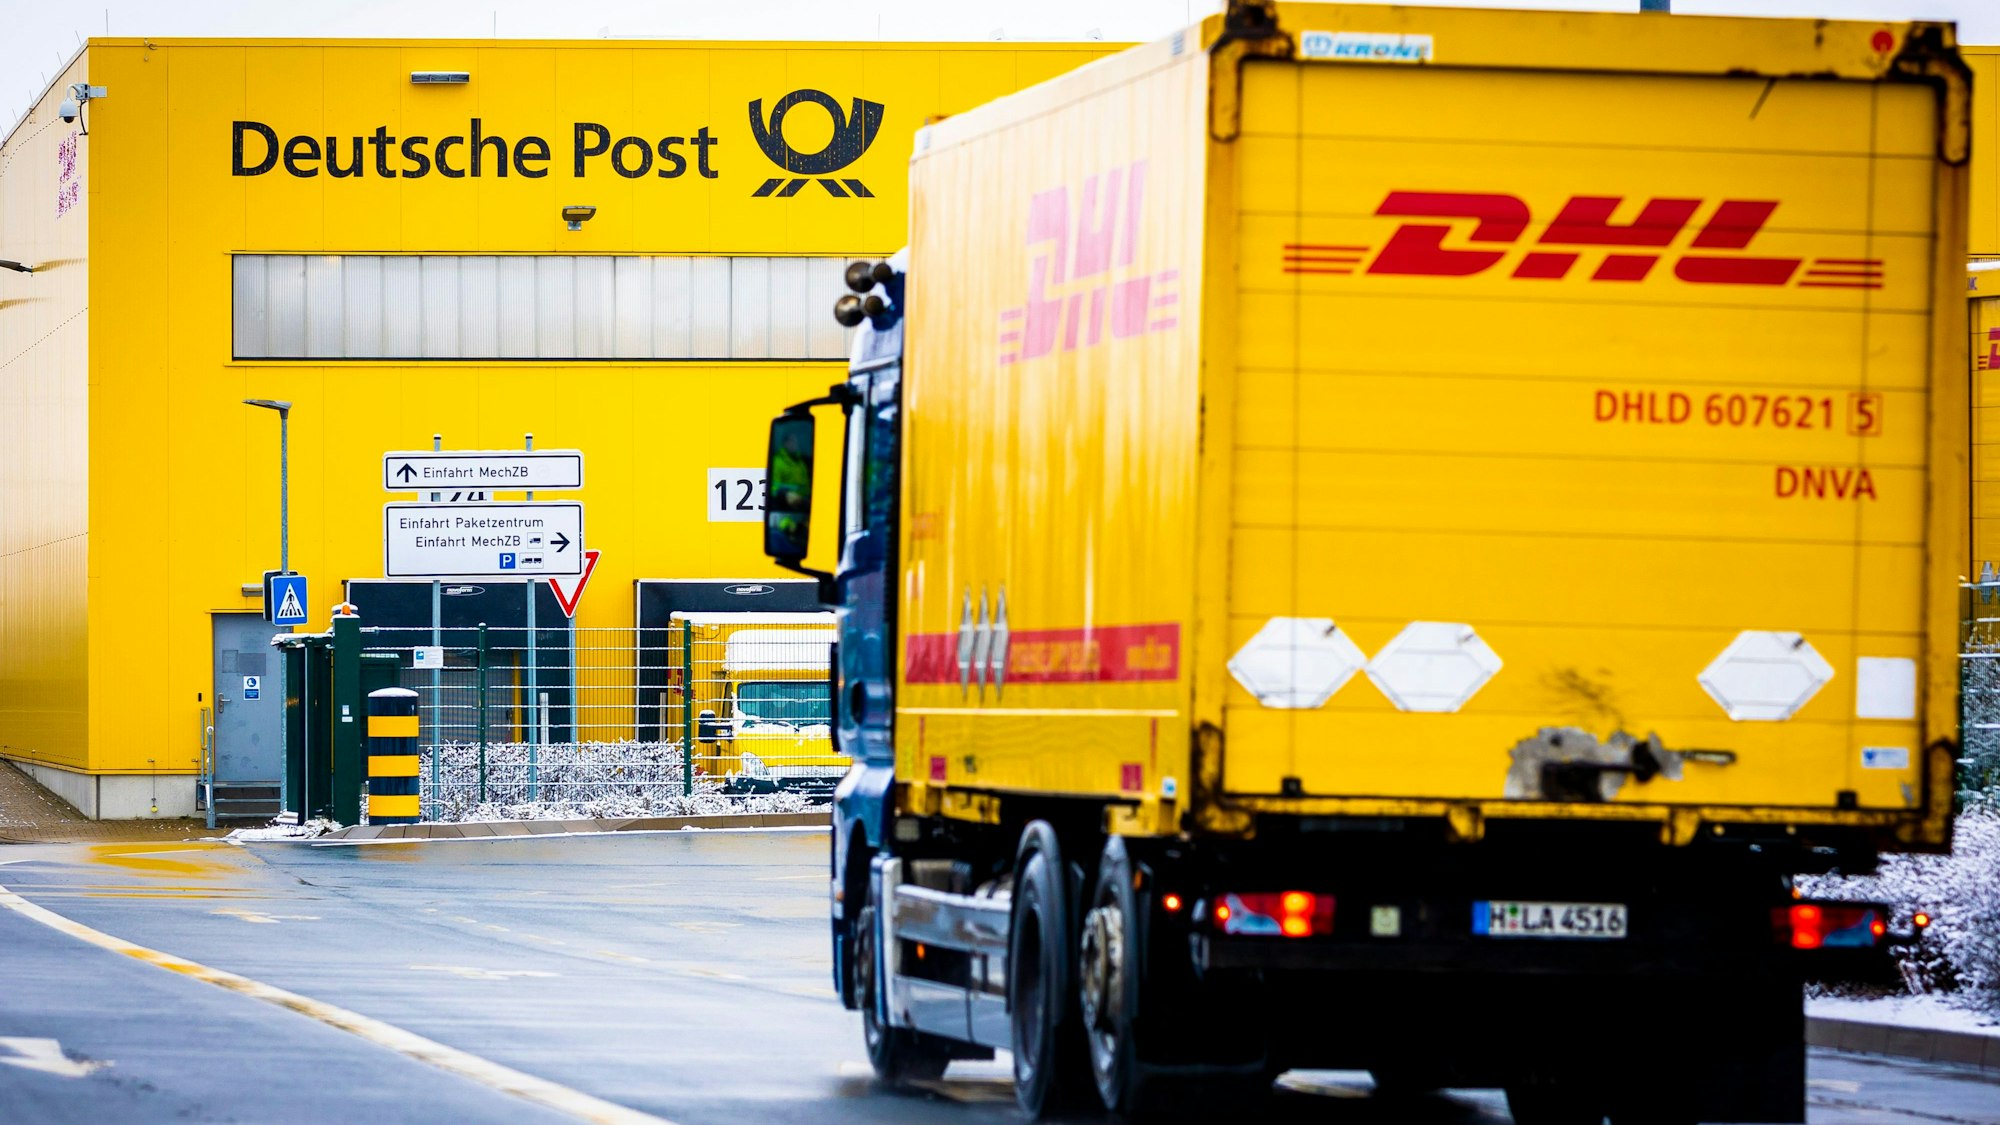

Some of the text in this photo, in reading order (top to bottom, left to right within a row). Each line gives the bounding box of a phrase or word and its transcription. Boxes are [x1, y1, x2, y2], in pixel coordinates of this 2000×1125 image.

[231, 118, 720, 179] Deutsche Post
[1365, 190, 1803, 286] DHL
[1594, 390, 1875, 431] DHLD 607621 5
[423, 466, 529, 478] Einfahrt MechZB
[1774, 466, 1878, 501] DNVA
[400, 516, 544, 529] Einfahrt Paketzentrum
[415, 535, 521, 548] Einfahrt MechZB
[1490, 907, 1621, 932] H LA 4516
